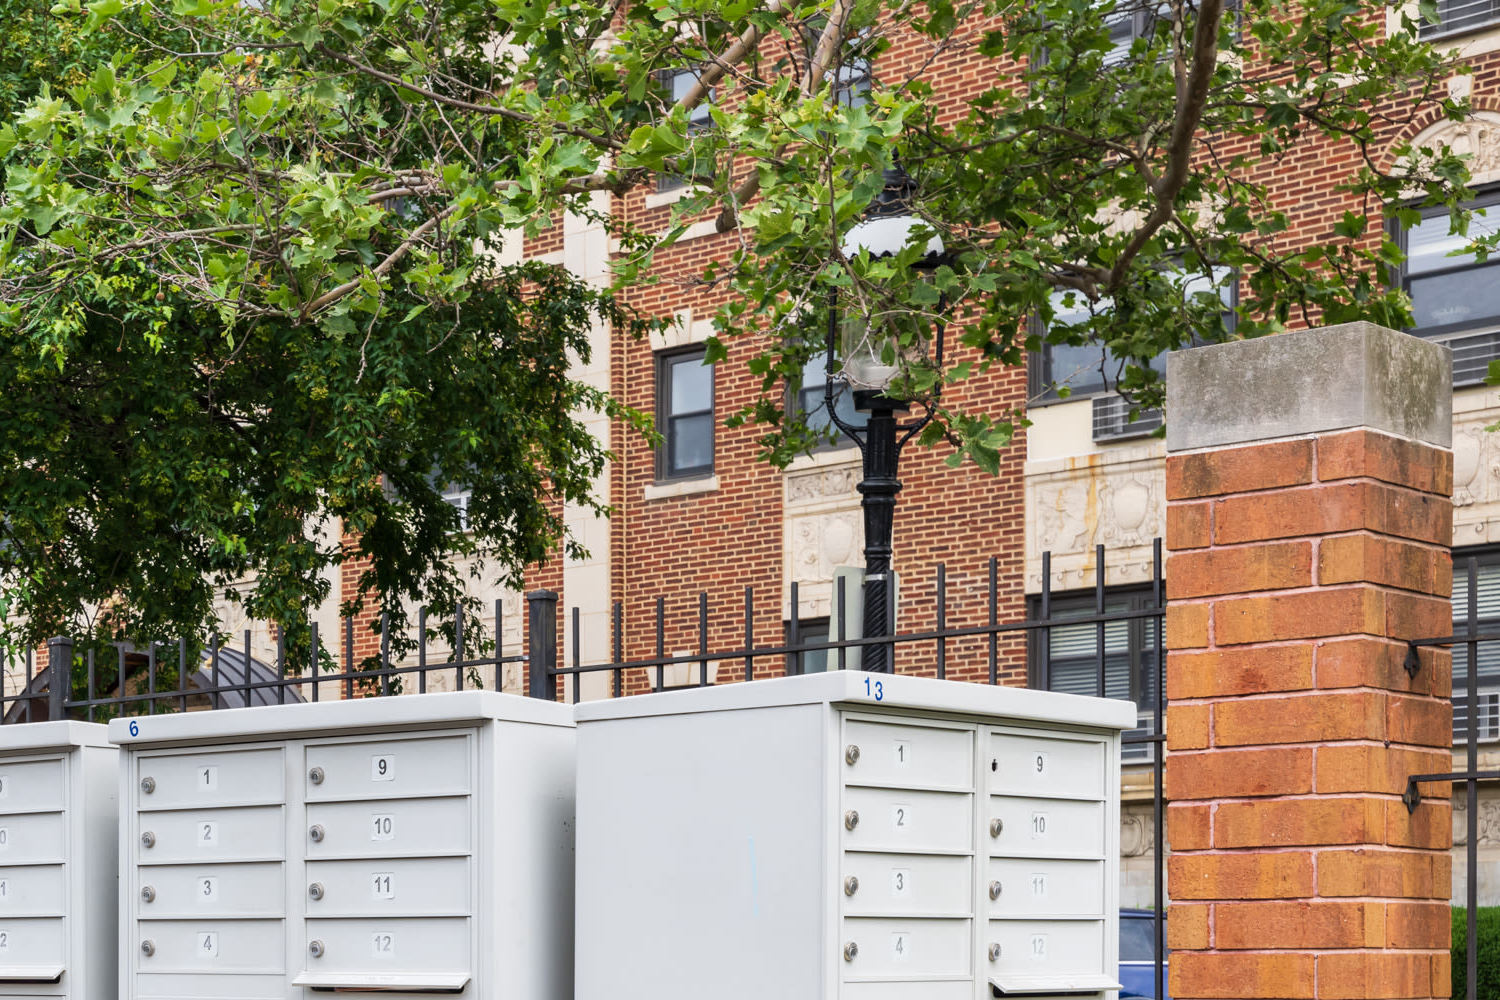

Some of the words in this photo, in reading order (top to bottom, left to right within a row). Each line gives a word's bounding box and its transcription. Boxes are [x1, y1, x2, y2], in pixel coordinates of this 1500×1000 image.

[864, 676, 884, 702] 13
[128, 720, 139, 738] 6
[898, 744, 904, 763] 1
[378, 758, 388, 776] 9
[1036, 755, 1044, 773] 9
[203, 768, 210, 785] 1
[374, 817, 392, 835] 10
[896, 808, 904, 827] 2
[1033, 816, 1046, 834] 10
[203, 824, 212, 841] 2
[203, 879, 212, 896] 3
[374, 876, 390, 894] 11
[896, 872, 904, 891] 3
[1032, 877, 1044, 895] 11
[203, 934, 212, 951] 4
[374, 935, 392, 952] 12
[895, 936, 904, 955] 4
[1031, 937, 1045, 955] 12
